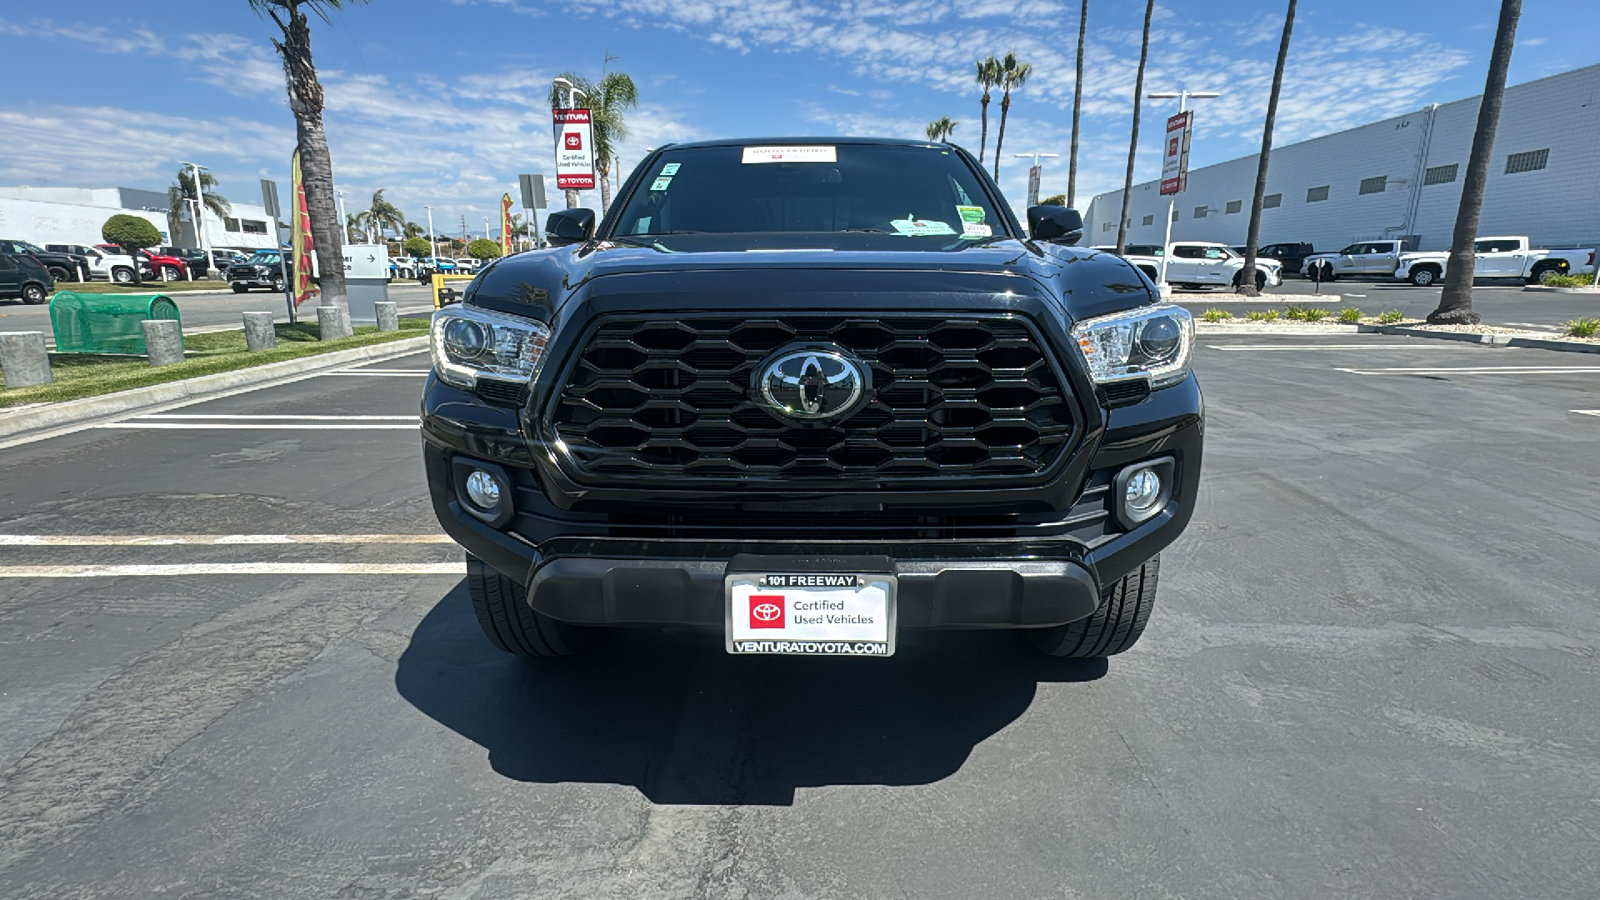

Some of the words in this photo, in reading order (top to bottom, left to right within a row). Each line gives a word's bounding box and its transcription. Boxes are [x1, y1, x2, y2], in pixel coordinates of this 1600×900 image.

[554, 113, 589, 121] VENTURA
[767, 576, 786, 586] 101
[789, 576, 854, 586] FREEWAY
[793, 600, 844, 611] Certified
[794, 614, 823, 625] Used
[827, 614, 874, 625] Vehicles
[734, 641, 886, 654] VENTURATOYOTA.COM
